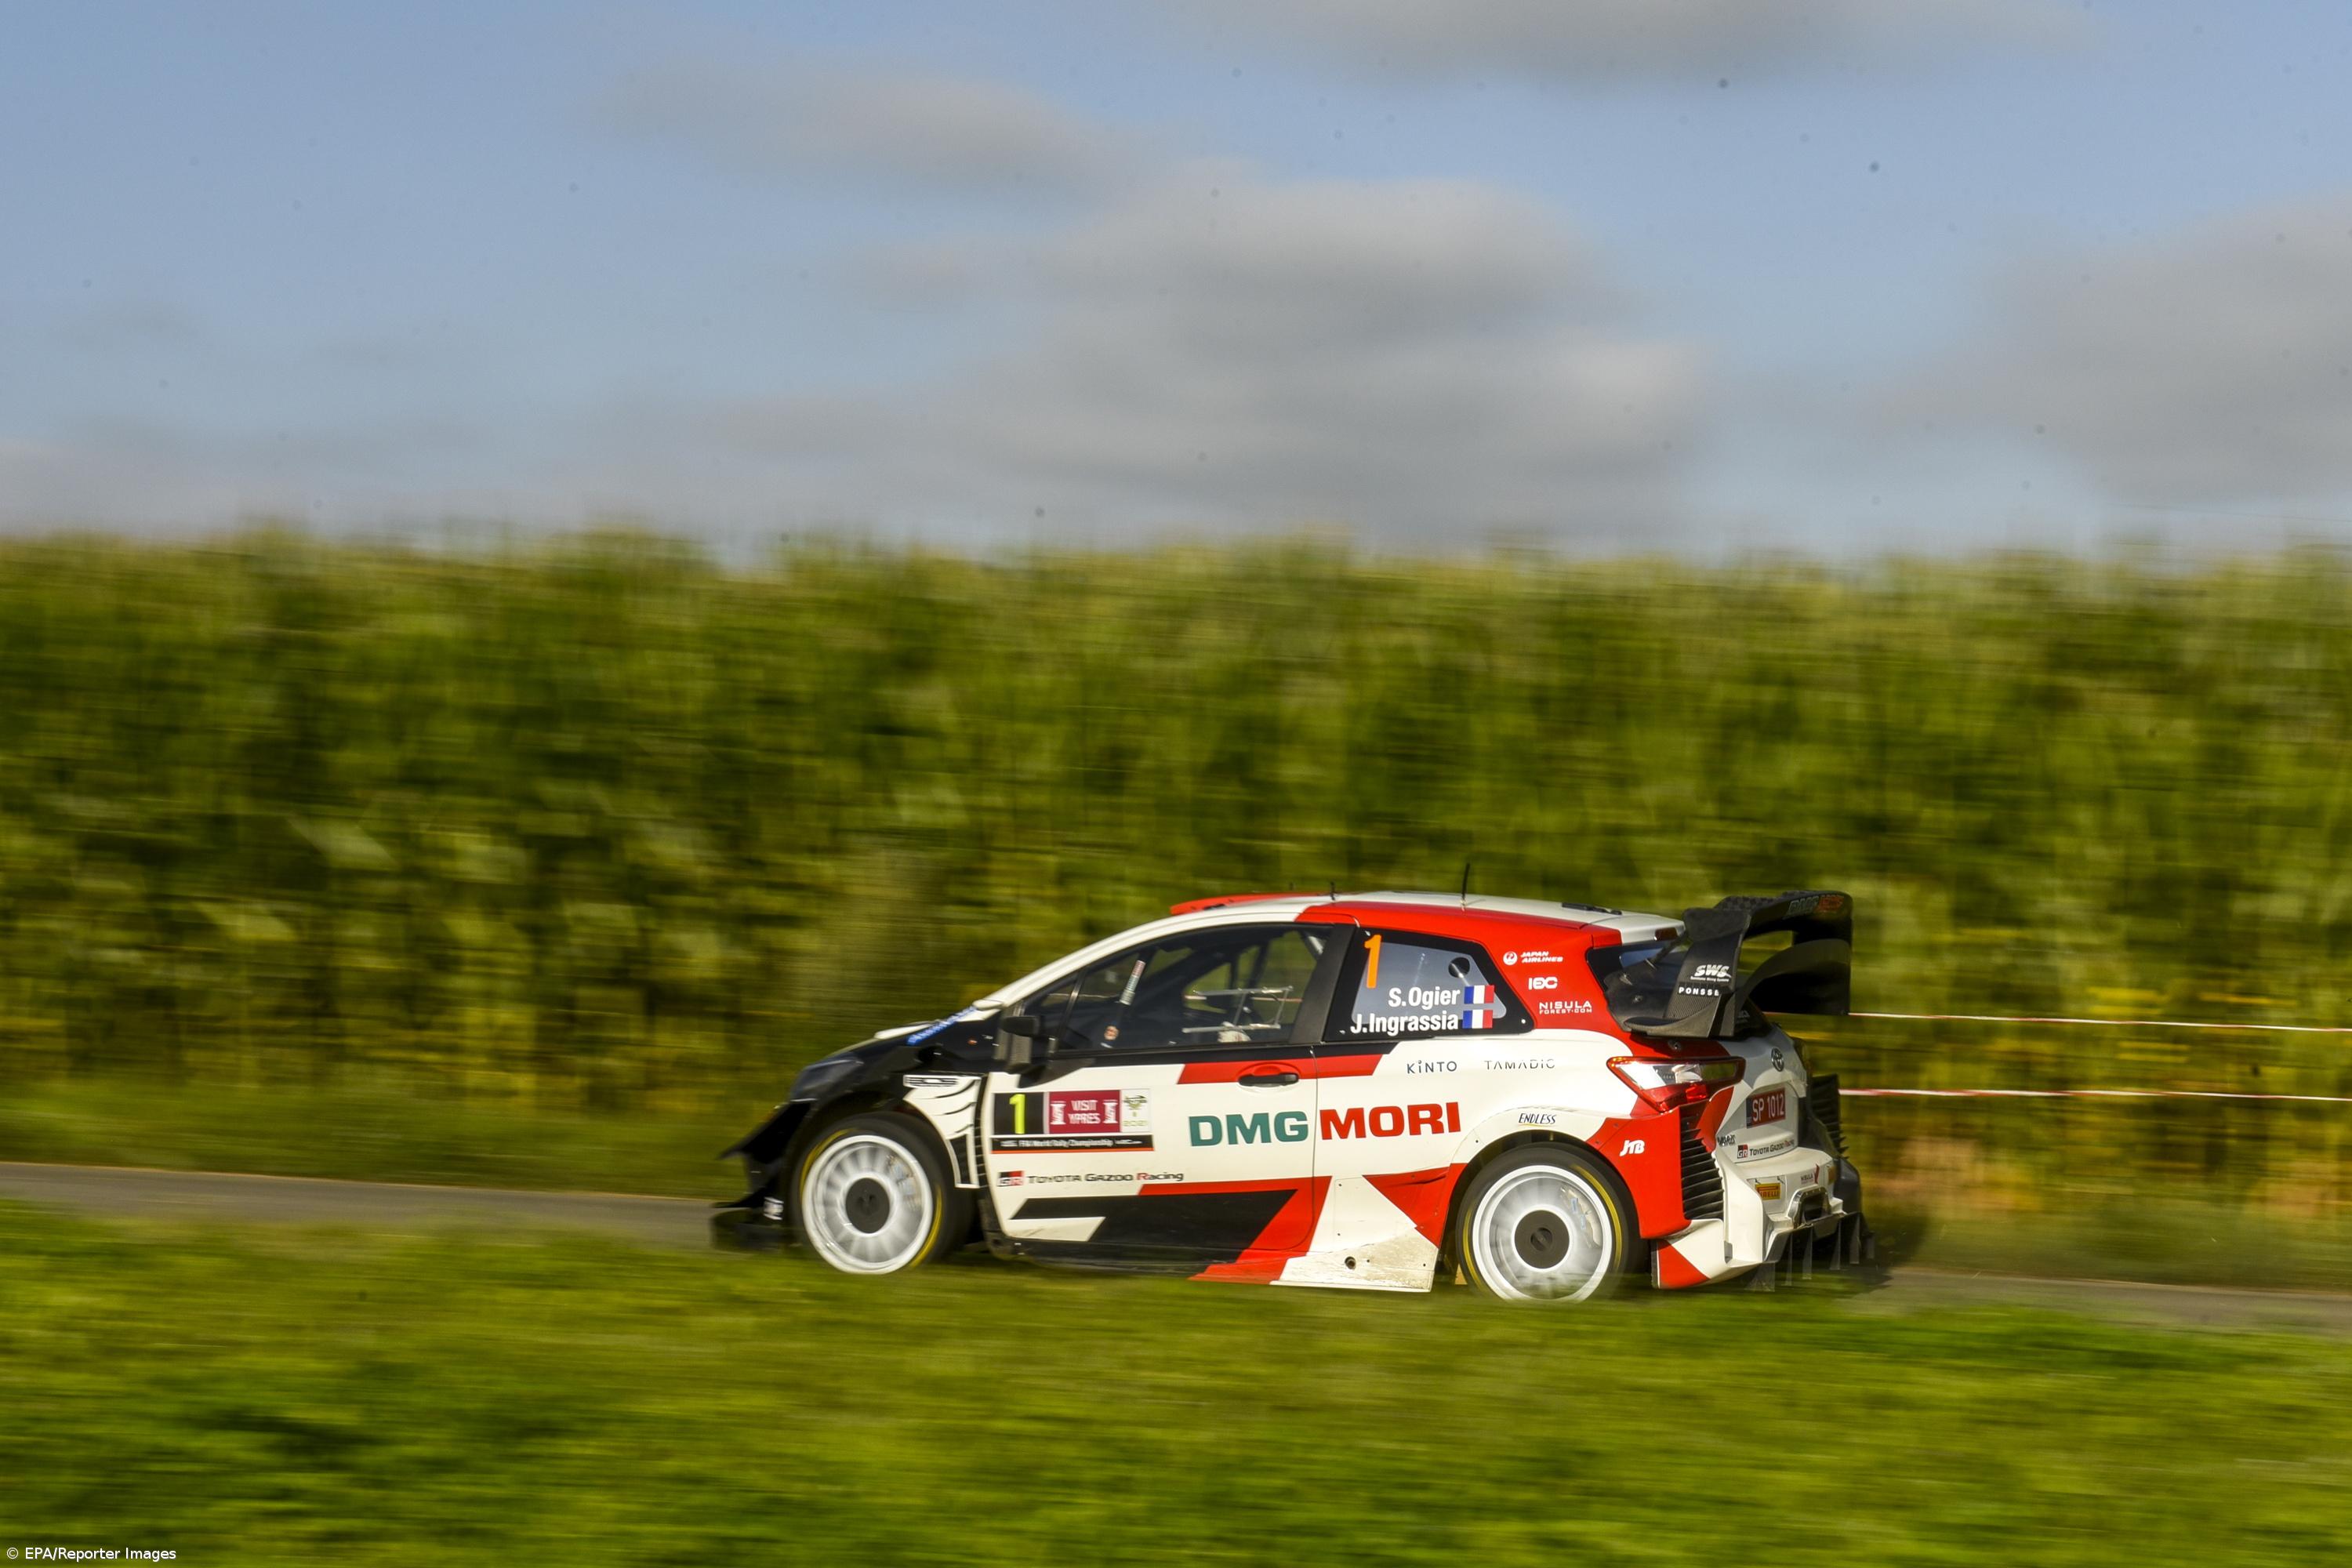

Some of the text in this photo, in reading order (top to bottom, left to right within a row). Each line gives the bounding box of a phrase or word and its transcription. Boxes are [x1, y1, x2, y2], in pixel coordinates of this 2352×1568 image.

[1363, 934, 1382, 989] 1
[1694, 964, 1732, 978] SWS
[1678, 986, 1719, 996] PONSSE
[1388, 986, 1461, 1010] S.Ogier
[1539, 1000, 1592, 1010] NISULA
[1350, 1010, 1459, 1036] J.Ingrassia
[1484, 1058, 1555, 1070] TAMADIC
[1071, 1099, 1098, 1112] VISIT
[1751, 1094, 1784, 1122] SP 1012
[1008, 1094, 1026, 1134] 1
[1067, 1112, 1102, 1125] YPRES
[1518, 1112, 1557, 1125] ENDLESS
[1189, 1101, 1461, 1147] DMG MORI
[1619, 1139, 1646, 1156] JTB
[1749, 1146, 1769, 1156] TOYOTA
[1026, 1175, 1081, 1184] TOYOTA
[1137, 1172, 1184, 1181] Racing
